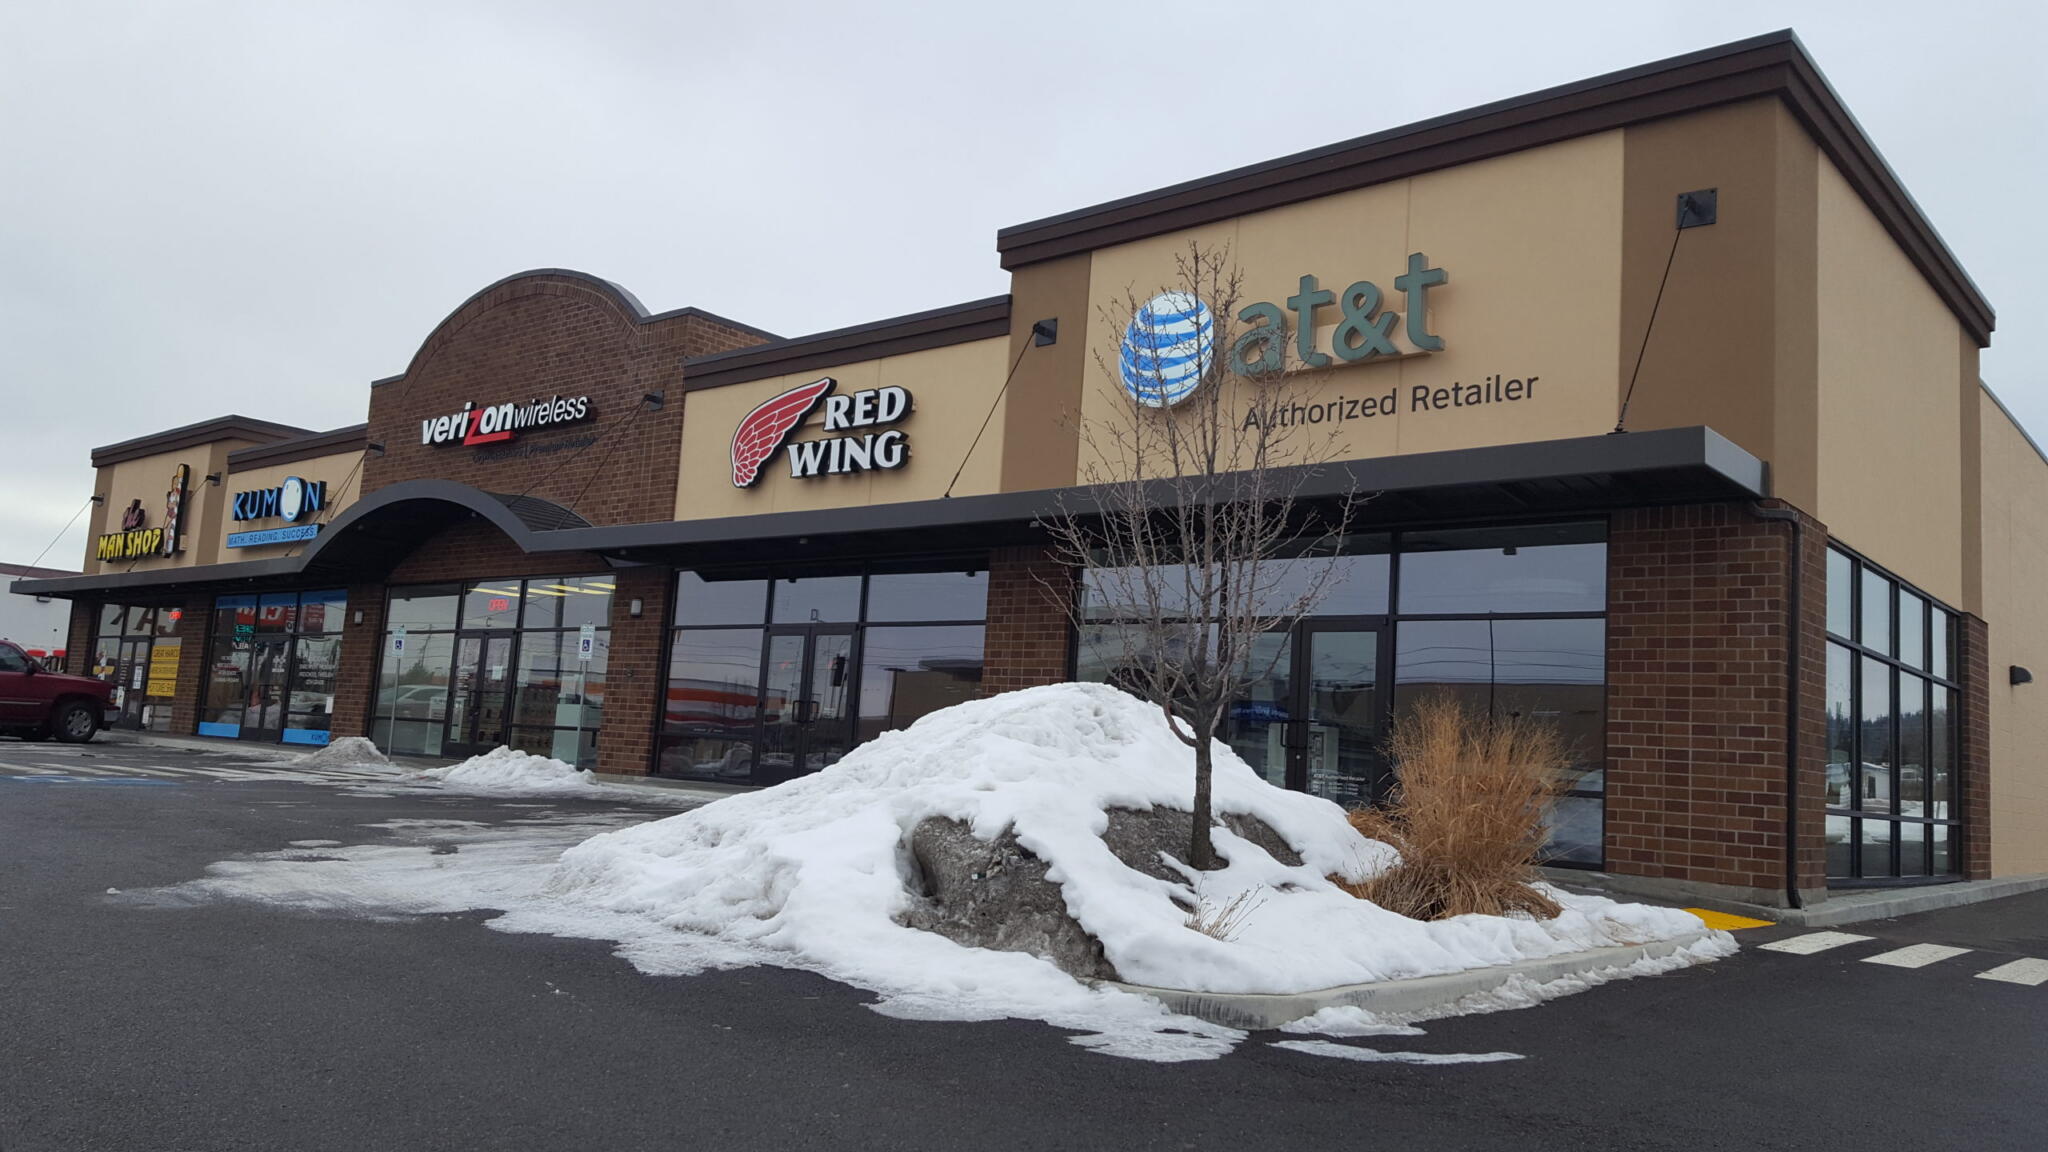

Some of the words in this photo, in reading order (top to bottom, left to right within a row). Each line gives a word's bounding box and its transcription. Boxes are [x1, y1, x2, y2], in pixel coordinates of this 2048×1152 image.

[1231, 252, 1448, 377] at&t
[824, 386, 907, 431] RED
[1411, 374, 1539, 412] Retailer
[787, 430, 904, 477] WING
[232, 476, 322, 522] KUMON
[97, 532, 125, 560] MAN
[126, 527, 162, 556] SHOP
